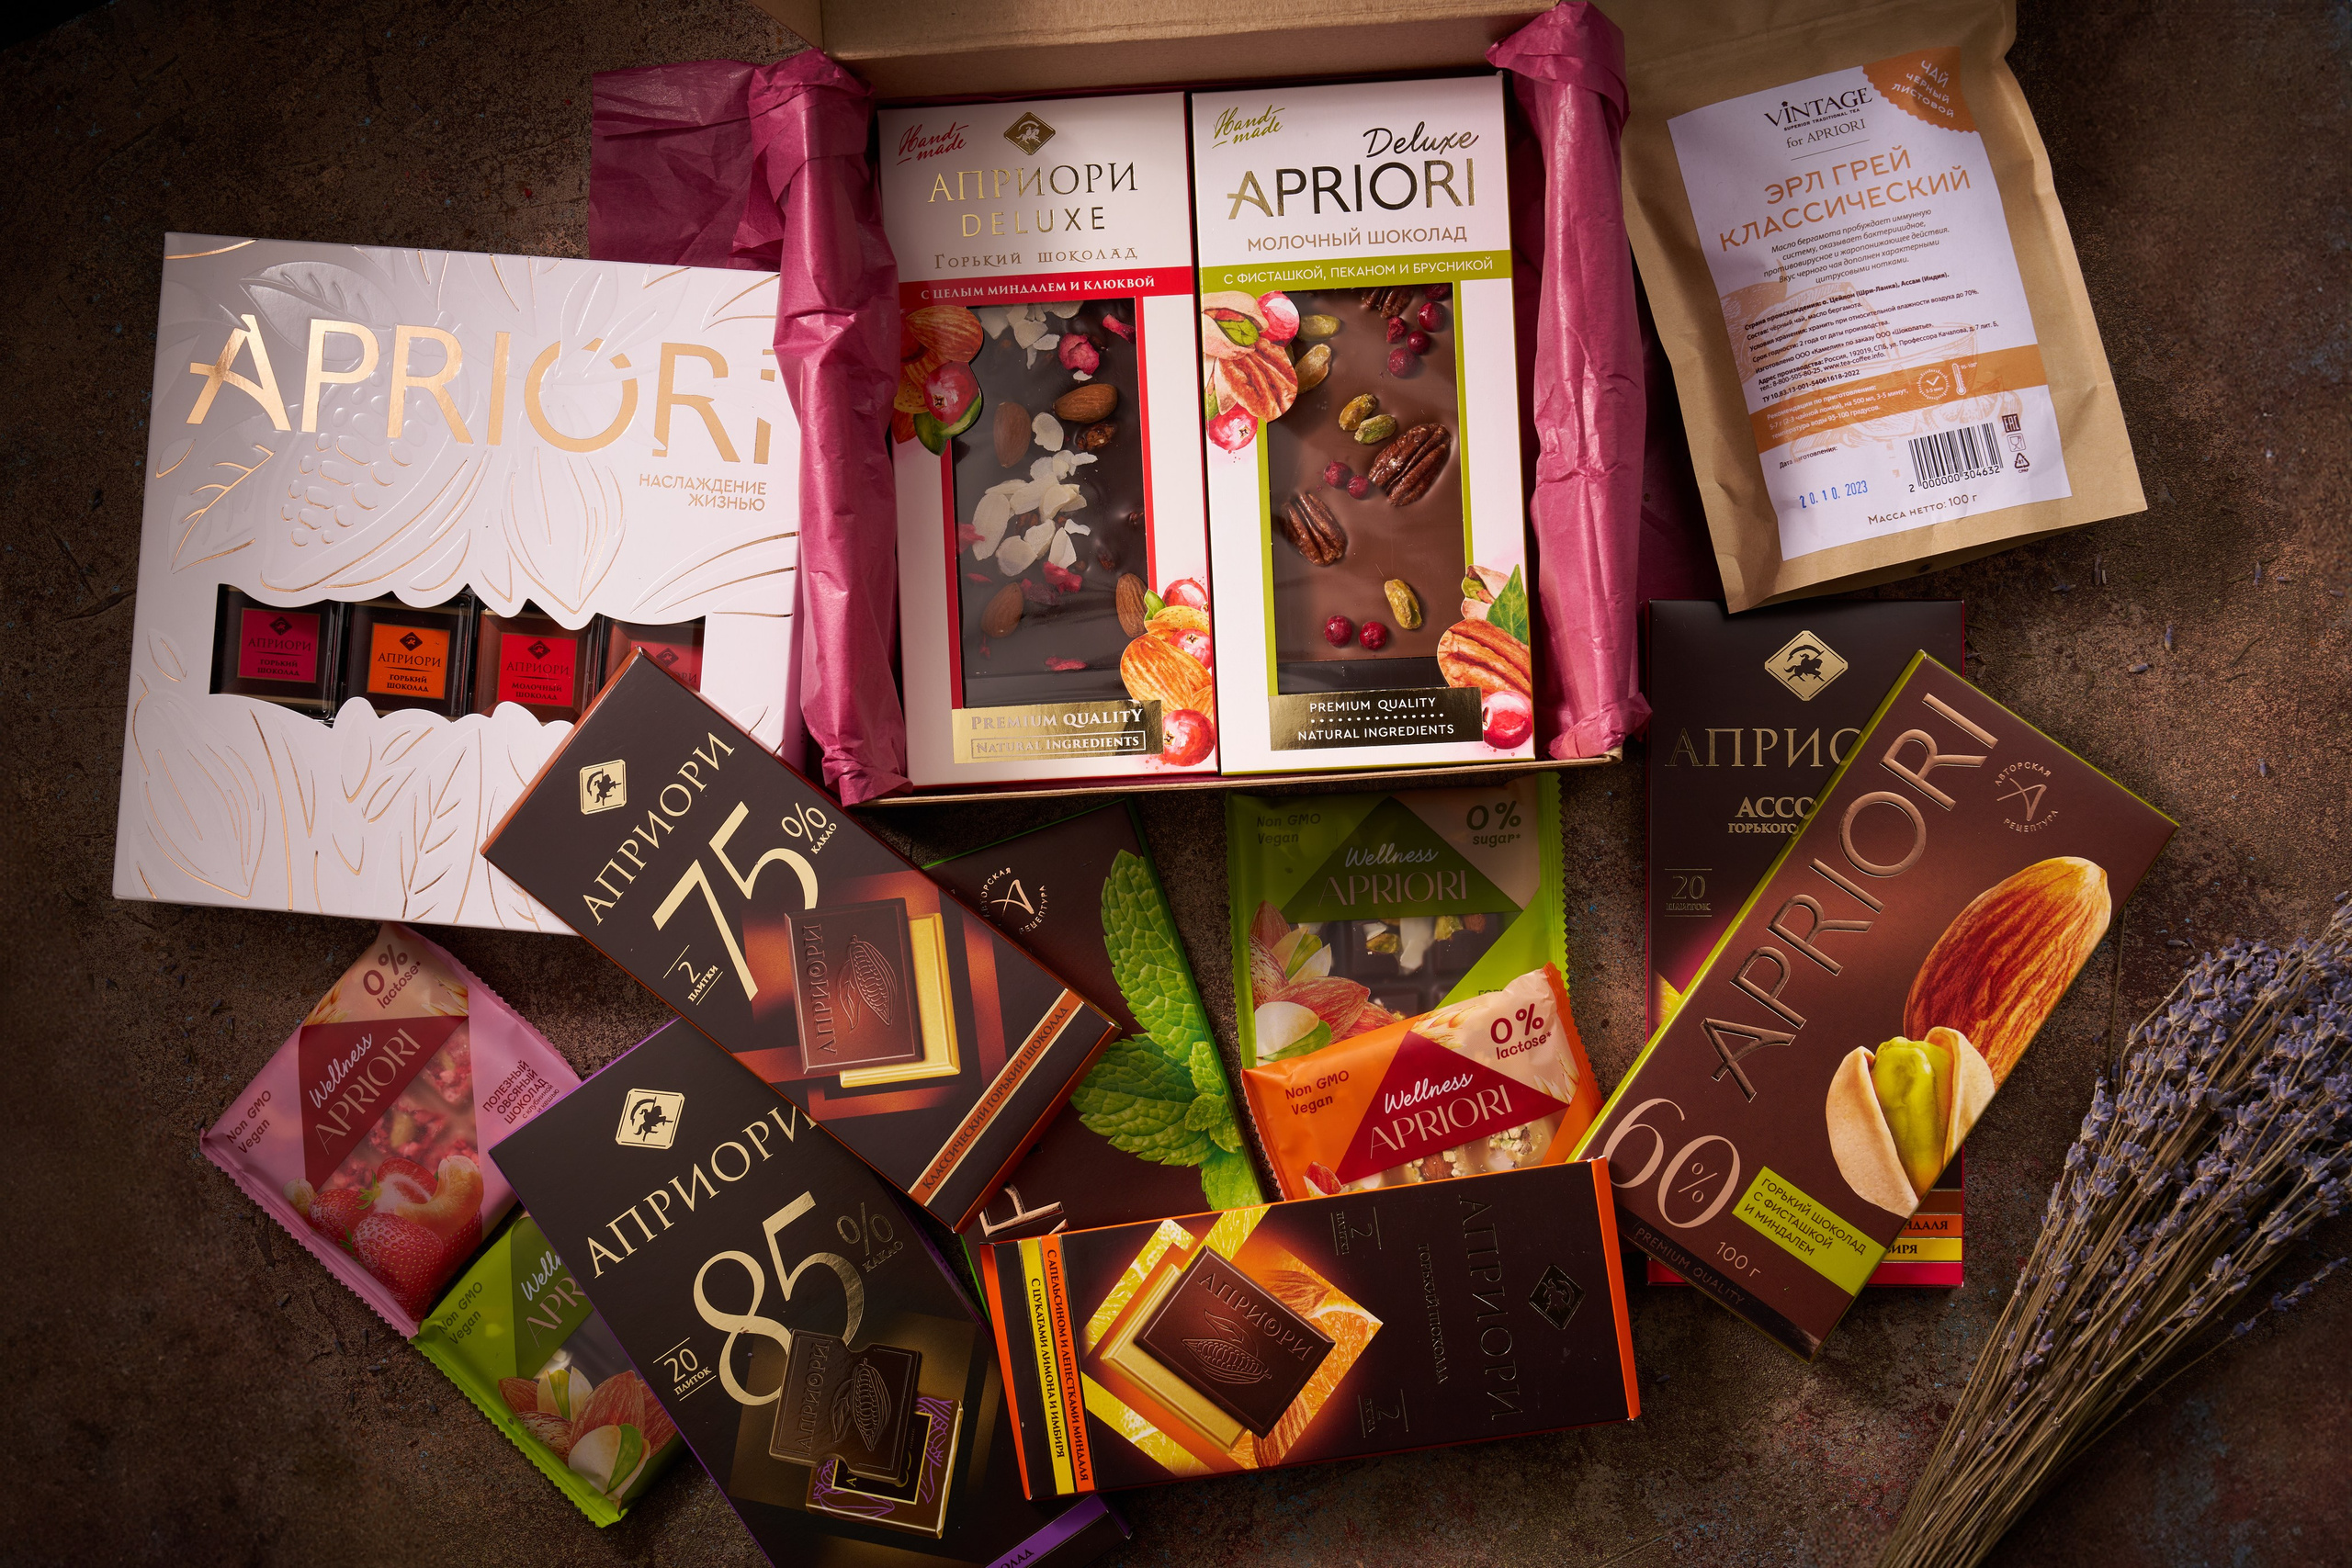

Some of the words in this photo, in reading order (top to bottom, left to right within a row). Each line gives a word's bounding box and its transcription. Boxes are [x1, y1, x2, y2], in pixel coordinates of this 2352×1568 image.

[1920, 60, 1949, 88] ЧАЙ
[1892, 83, 1955, 118] ЛИСТОВОЙ
[1363, 121, 1479, 158] Deluxe
[1787, 137, 1803, 148] for
[1808, 118, 1865, 142] APRIORI
[928, 162, 1137, 202] АПРИОРИ
[1227, 158, 1474, 220] APRIORI
[1765, 171, 1825, 204] ЭРЛ
[1832, 145, 1911, 186] ГРЕЙ
[963, 207, 1104, 236] DELUXE
[1720, 164, 1972, 253] КЛАССИЧЕСКИЙ
[1248, 228, 1360, 252] МОЛОЧНЫЙ
[1368, 226, 1466, 244] ШОКОЛАД
[1224, 274, 1233, 284] С
[1238, 265, 1326, 283] ФИСТАШКОЙ,
[1331, 265, 1395, 277] ПЕКАНОМ
[1400, 265, 1408, 274] И
[1414, 256, 1492, 273] БРУСНИКОЙ
[922, 290, 929, 299] С
[933, 288, 983, 298] ЦЕЛЫМ
[989, 283, 1066, 295] МИНДАЛЕМ
[1070, 282, 1079, 290] И
[1084, 276, 1154, 289] КЛЮКВОЙ
[186, 314, 775, 465] APRIORI
[639, 473, 766, 495] НАСЛАЖДЕНИЕ
[1962, 465, 2000, 479] 304632
[687, 493, 765, 512] ЖИЗНЬЮ
[1948, 494, 1969, 507] 100
[248, 637, 311, 651] АПРИОРИ
[378, 652, 440, 667] АПРИОРИ
[256, 667, 300, 677] ШОКОЛАД
[259, 660, 298, 669] ГОРЬКИЙ
[388, 674, 427, 683] ГОРЬКИЙ
[506, 661, 569, 675] АПРИОРИ
[386, 682, 428, 693] ШОКОЛАД
[511, 682, 562, 693] МОЛОЧНЫЙ
[514, 692, 557, 701] ШОКОЛАД
[971, 713, 1057, 730] PREMIUM
[1063, 708, 1143, 728] QUALITY
[1310, 701, 1371, 713] PREMIUM
[1378, 697, 1436, 711] QUALITY
[977, 740, 1042, 754] NATURAL
[1046, 736, 1140, 750] INGREDIENTS
[1298, 728, 1360, 741] NATURAL
[1364, 724, 1454, 739] INGREDIENTS
[1995, 761, 2052, 787] АВТОРСКАЯ
[583, 732, 735, 926] АПРИОРИ
[2003, 808, 2059, 833] РЕЦЕПТУРА
[811, 823, 836, 854] КАКАО
[1345, 843, 1439, 867] Wellness
[1318, 871, 1466, 907] APRIORI
[1701, 693, 1997, 1102] APRIORI
[688, 965, 718, 1001] ПЛИТКИ
[309, 1033, 371, 1108] Wellness
[483, 1060, 529, 1111] ПОЛЕЗНЫЙ
[1285, 1086, 1312, 1100] Non
[1317, 1071, 1349, 1089] GMO
[314, 1028, 421, 1155] APRIORI
[497, 1068, 537, 1113] ОВСЯНЫЙ
[504, 1078, 548, 1124] ШОКОЛАД
[919, 1104, 989, 1190] КЛАССИЧЕСКИЙ
[981, 1055, 1026, 1108] ГОРЬКИЙ
[1023, 1009, 1069, 1060] ШОКОЛАД
[1292, 1096, 1332, 1115] Vegan
[1385, 1074, 1473, 1113] Wellness
[226, 1120, 248, 1144] Non
[248, 1091, 271, 1119] GMO
[1370, 1085, 1512, 1158] APRIORI
[238, 1120, 270, 1153] Vegan
[588, 1107, 817, 1279] АПРИОРИ
[1744, 1203, 1755, 1214] И
[1755, 1211, 1815, 1256] МИНДАЛЕМ
[1754, 1192, 1763, 1201] С
[1764, 1200, 1833, 1249] ФИСТАШКОЙ
[1762, 1179, 1812, 1215] ГОРЬКИЙ
[1811, 1213, 1866, 1255] ШОКОЛАД
[1047, 1249, 1057, 1258] С
[436, 1312, 458, 1334] Non
[458, 1282, 482, 1310] GMO
[1049, 1260, 1067, 1337] АПЕЛЬСИНОМ
[449, 1312, 481, 1344] Vegan
[1033, 1289, 1047, 1348] ЦУКАТАМИ
[1060, 1339, 1068, 1348] И
[663, 1348, 698, 1382] 20
[674, 1367, 711, 1394] ПЛИТОК
[1042, 1350, 1055, 1399] ЛИМОНА
[1062, 1350, 1080, 1423] ЛЕПЕСТКАМИ
[1049, 1400, 1057, 1409] И
[1051, 1411, 1064, 1458] ИМБИРЯ
[1073, 1427, 1088, 1481] МИНДАЛЯ
